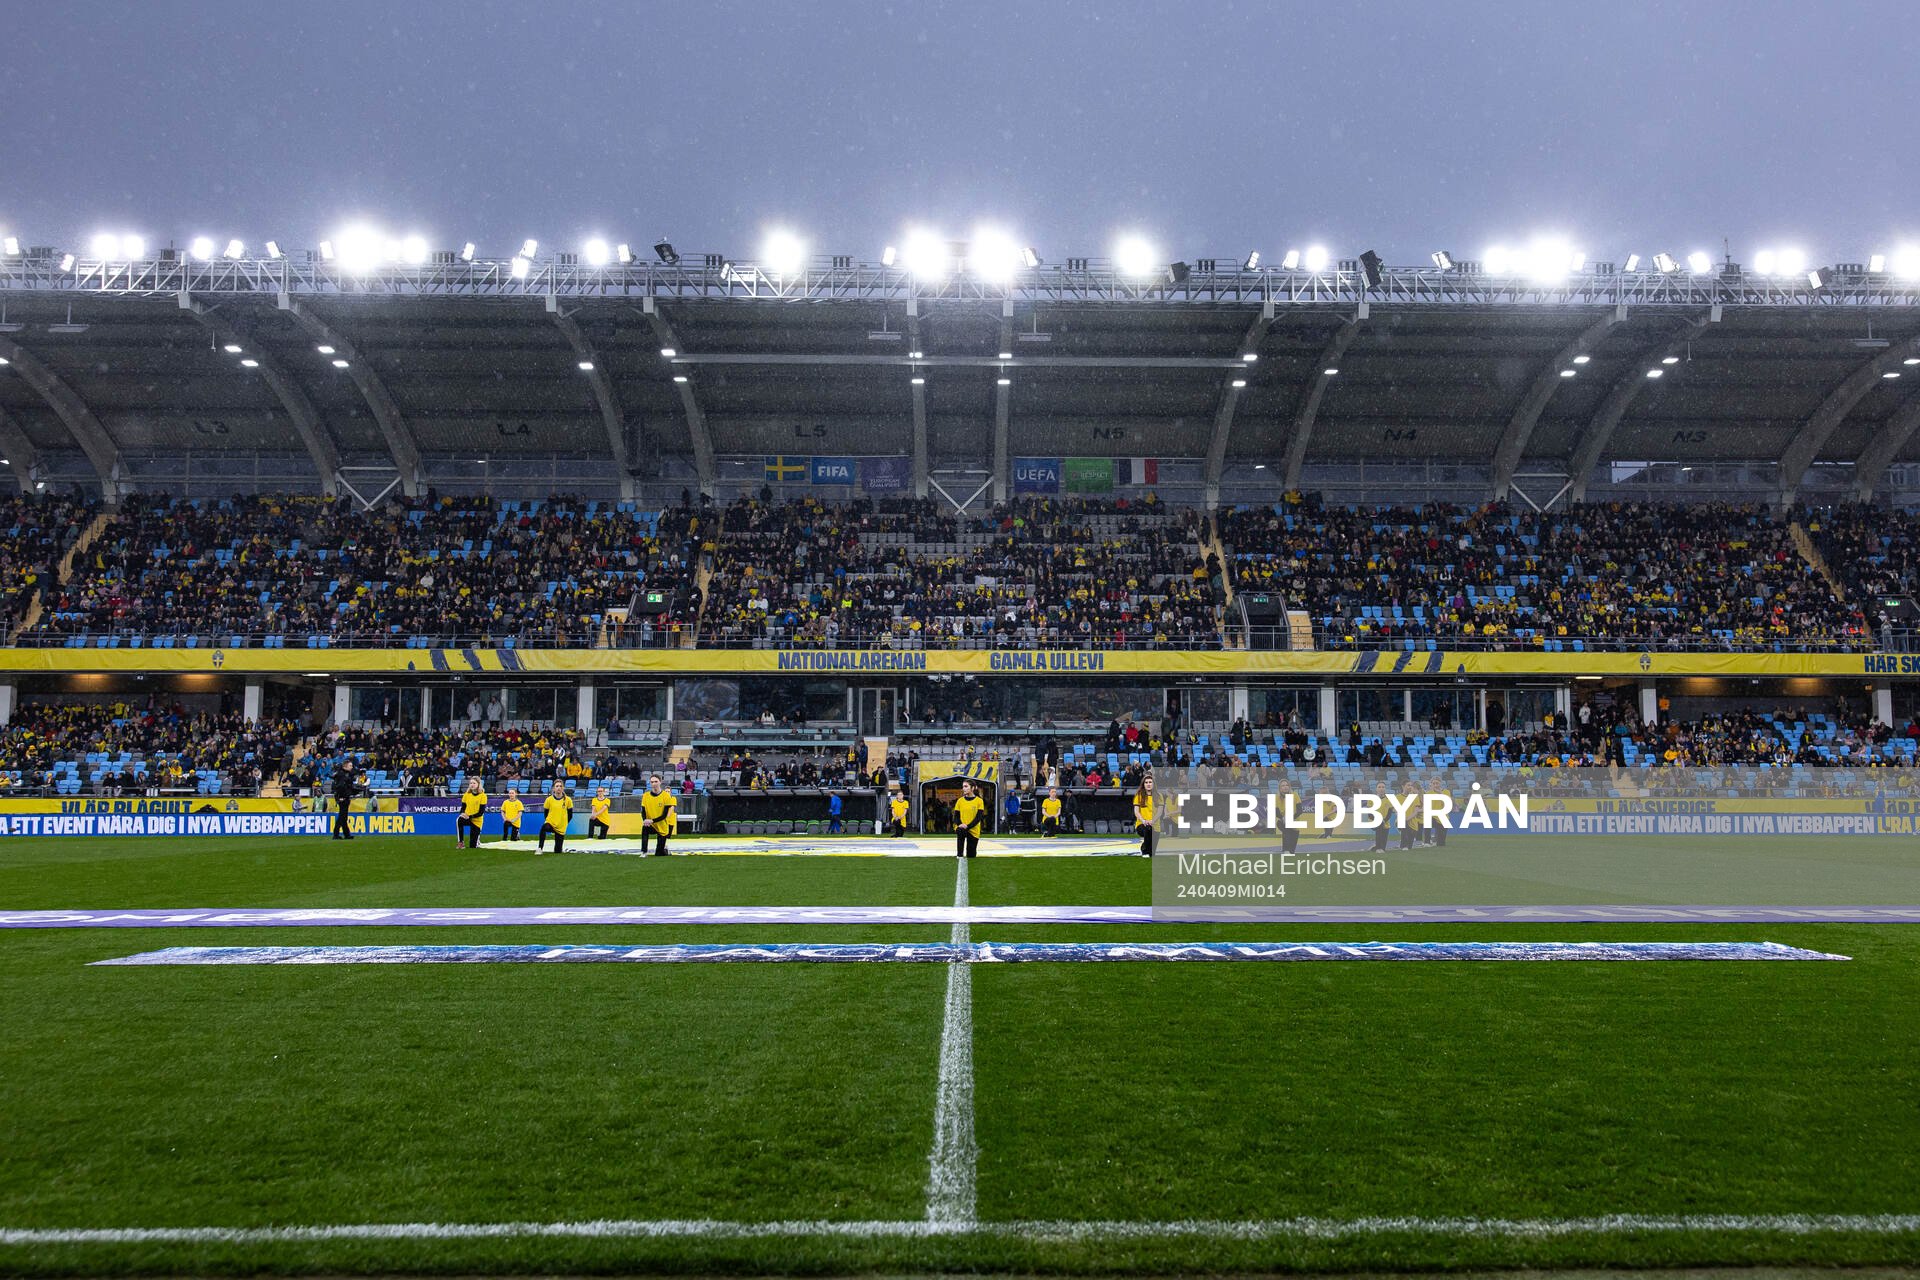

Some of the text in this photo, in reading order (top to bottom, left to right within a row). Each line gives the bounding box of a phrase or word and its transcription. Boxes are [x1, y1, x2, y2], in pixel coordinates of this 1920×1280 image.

[818, 466, 848, 477] FIFA
[1017, 469, 1056, 480] UEFA
[778, 652, 1104, 670] NATIONALARENAN GAMLA ULLEVI
[1864, 654, 1898, 672] HÄR
[15, 817, 40, 834] ETT
[43, 816, 95, 834] EVENT
[98, 815, 144, 834] NÄRA
[147, 816, 176, 833] DIG
[179, 816, 184, 833] I
[188, 816, 221, 833] NYA
[224, 815, 327, 833] WEBBAPPEN
[369, 815, 415, 833] MERA
[1530, 815, 1574, 833] HITTA
[1577, 815, 1604, 833] ETT
[1607, 815, 1655, 833] EVENT
[1658, 814, 1702, 833] NÄRA
[1705, 816, 1732, 833] DIG
[1734, 816, 1740, 833] I
[1743, 816, 1774, 833] NYA
[1777, 816, 1874, 833] WEBBAPPEN
[1877, 816, 1912, 833] LIRA
[536, 947, 958, 959] PEACE
